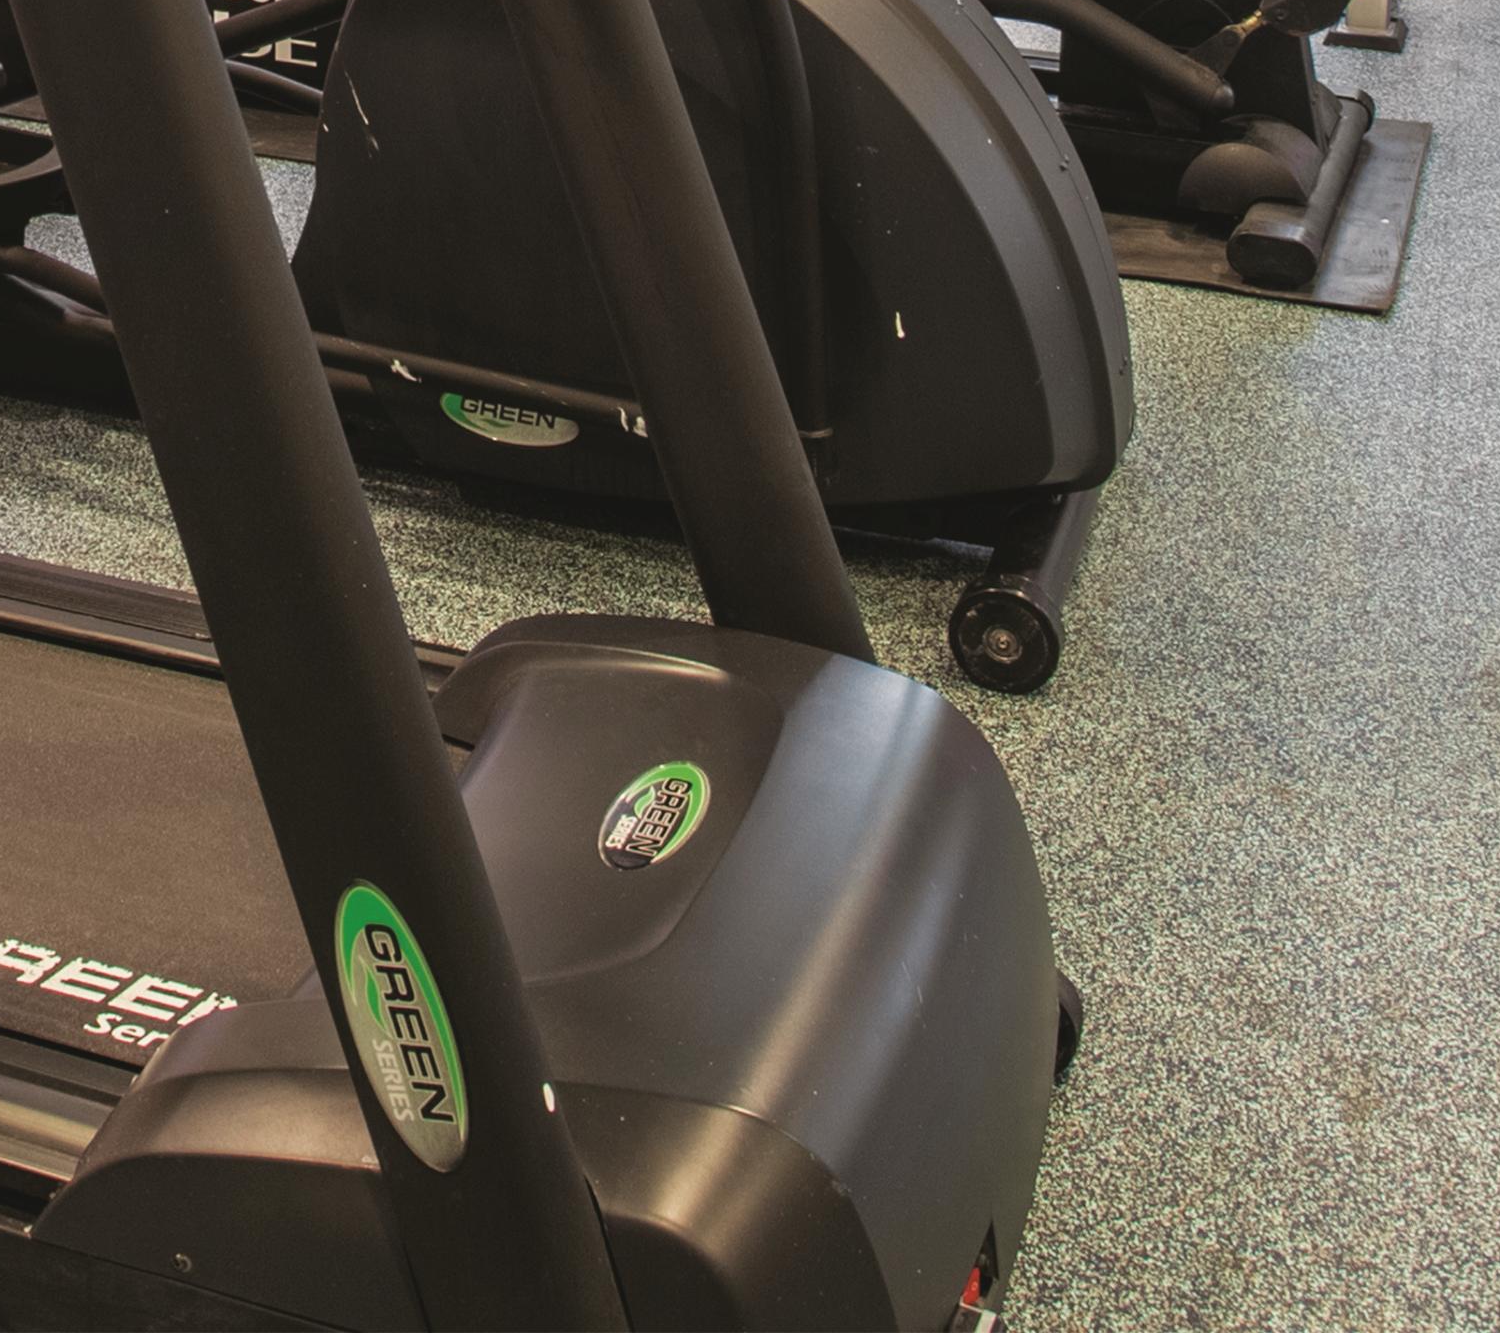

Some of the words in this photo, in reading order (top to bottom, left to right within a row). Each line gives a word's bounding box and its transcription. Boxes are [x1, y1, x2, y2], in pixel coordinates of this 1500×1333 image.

[460, 398, 557, 430] GREEN
[624, 777, 693, 857] GREEN
[361, 922, 455, 1126] GREEN
[371, 1037, 415, 1123] SERIES
